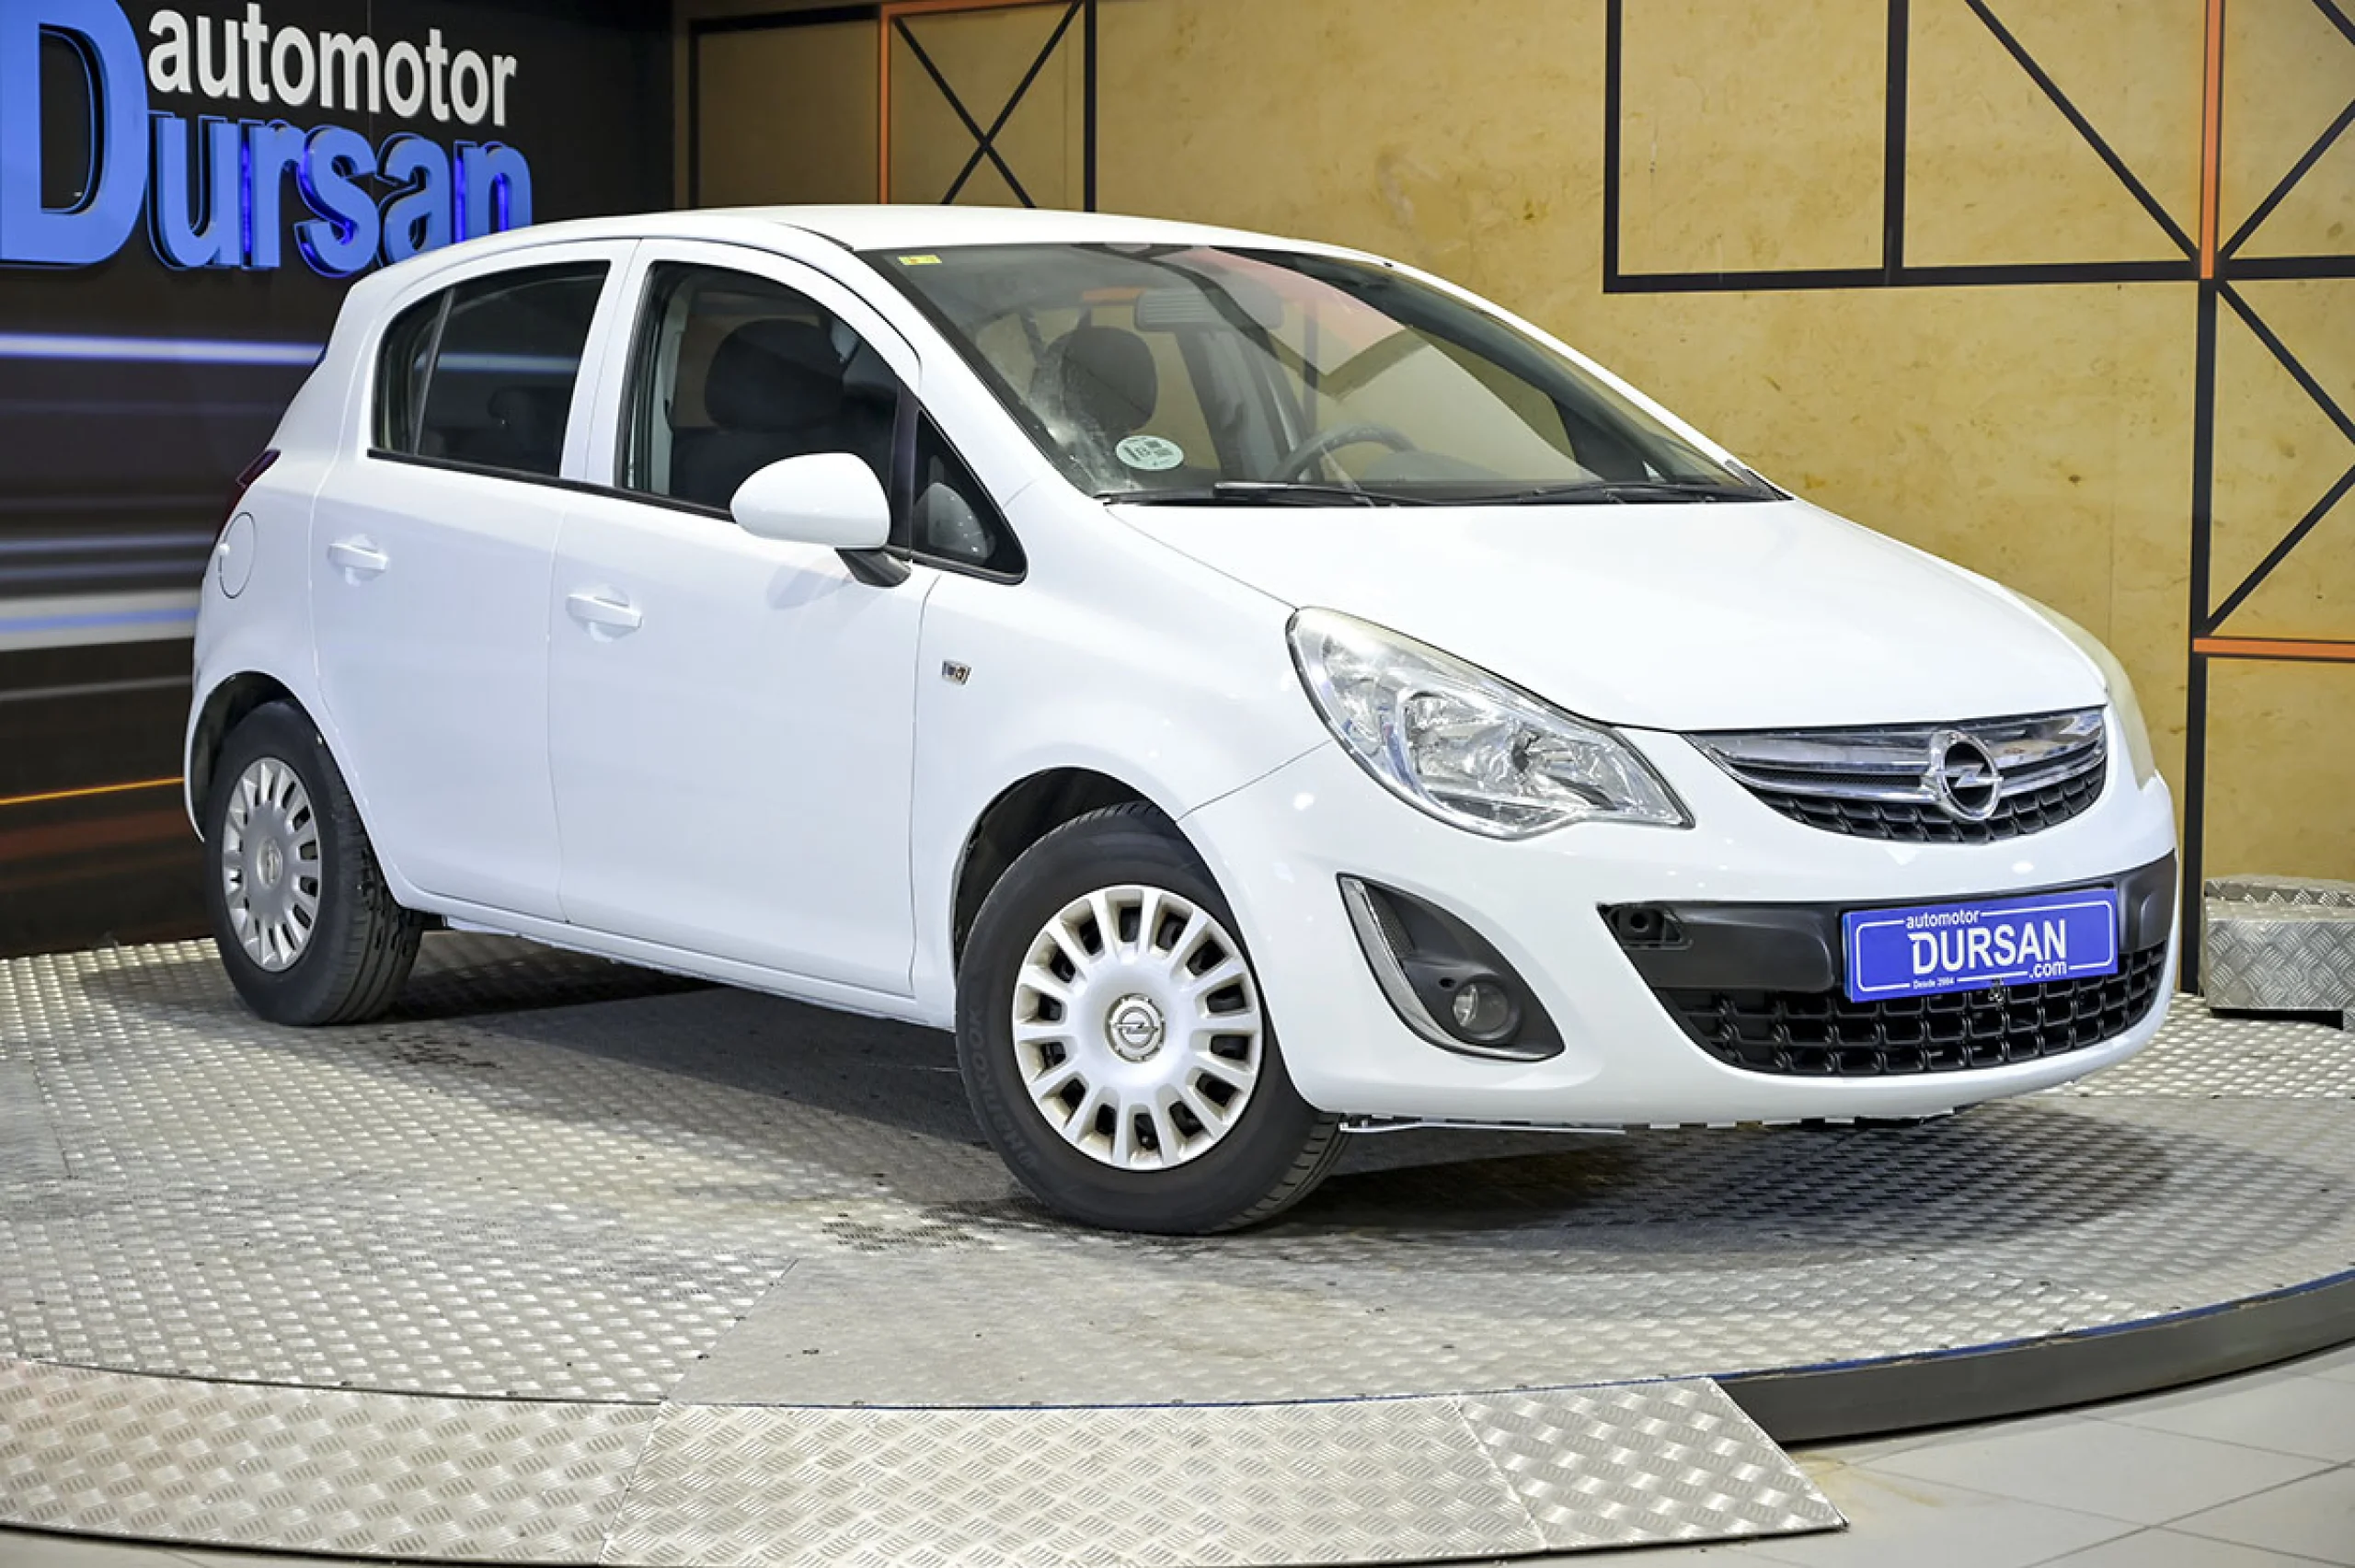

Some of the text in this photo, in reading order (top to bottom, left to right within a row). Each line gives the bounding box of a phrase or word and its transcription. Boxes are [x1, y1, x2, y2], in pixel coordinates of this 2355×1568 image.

[147, 3, 517, 126] automotor
[0, 0, 532, 275] Dursan
[1906, 909, 1981, 929] automotor
[1907, 919, 2067, 975] DURSAN
